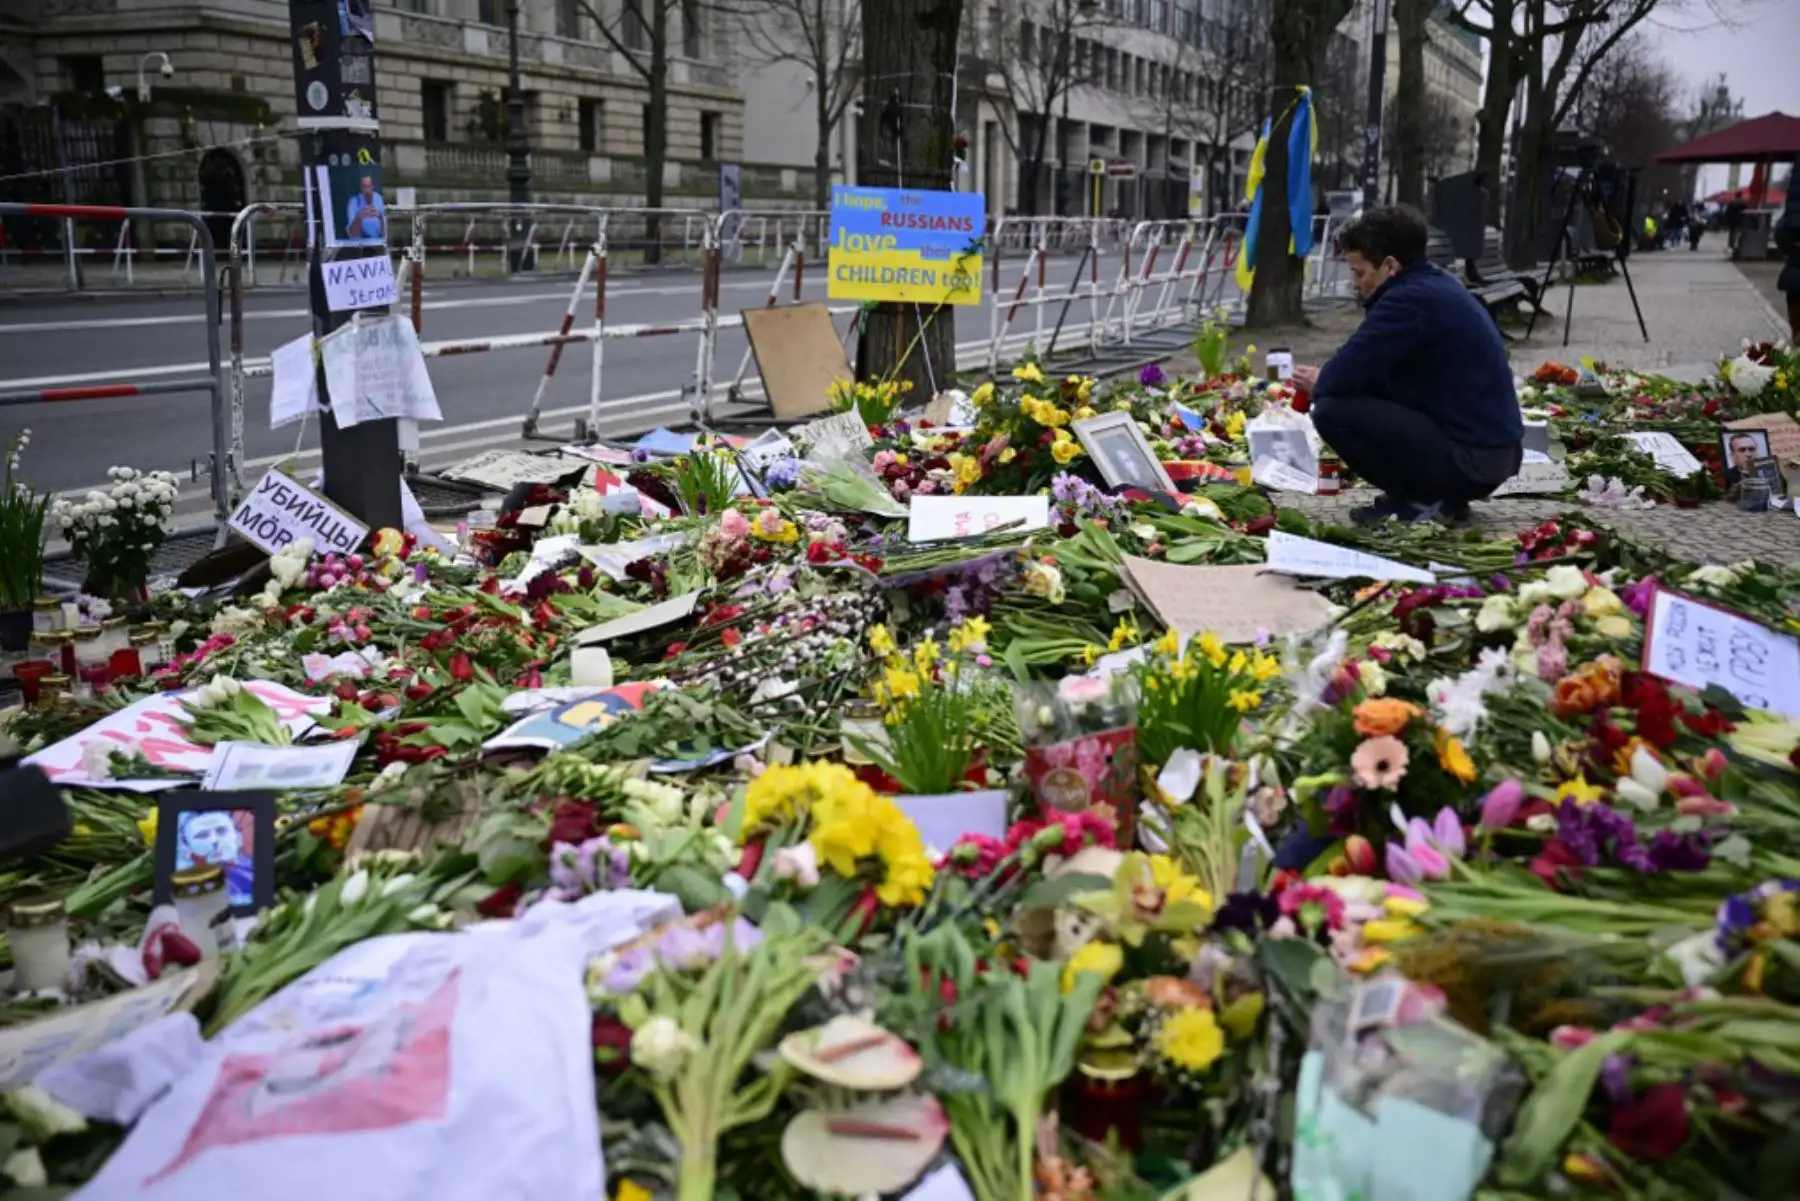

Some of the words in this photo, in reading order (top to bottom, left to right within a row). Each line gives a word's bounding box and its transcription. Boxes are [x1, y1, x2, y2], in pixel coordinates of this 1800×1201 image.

[880, 211, 974, 233] RUSSIANS
[838, 226, 898, 253] love
[836, 264, 937, 287] CHILDREN
[235, 503, 297, 548] MÖR
[257, 475, 360, 552] УБИЙЦЫ
